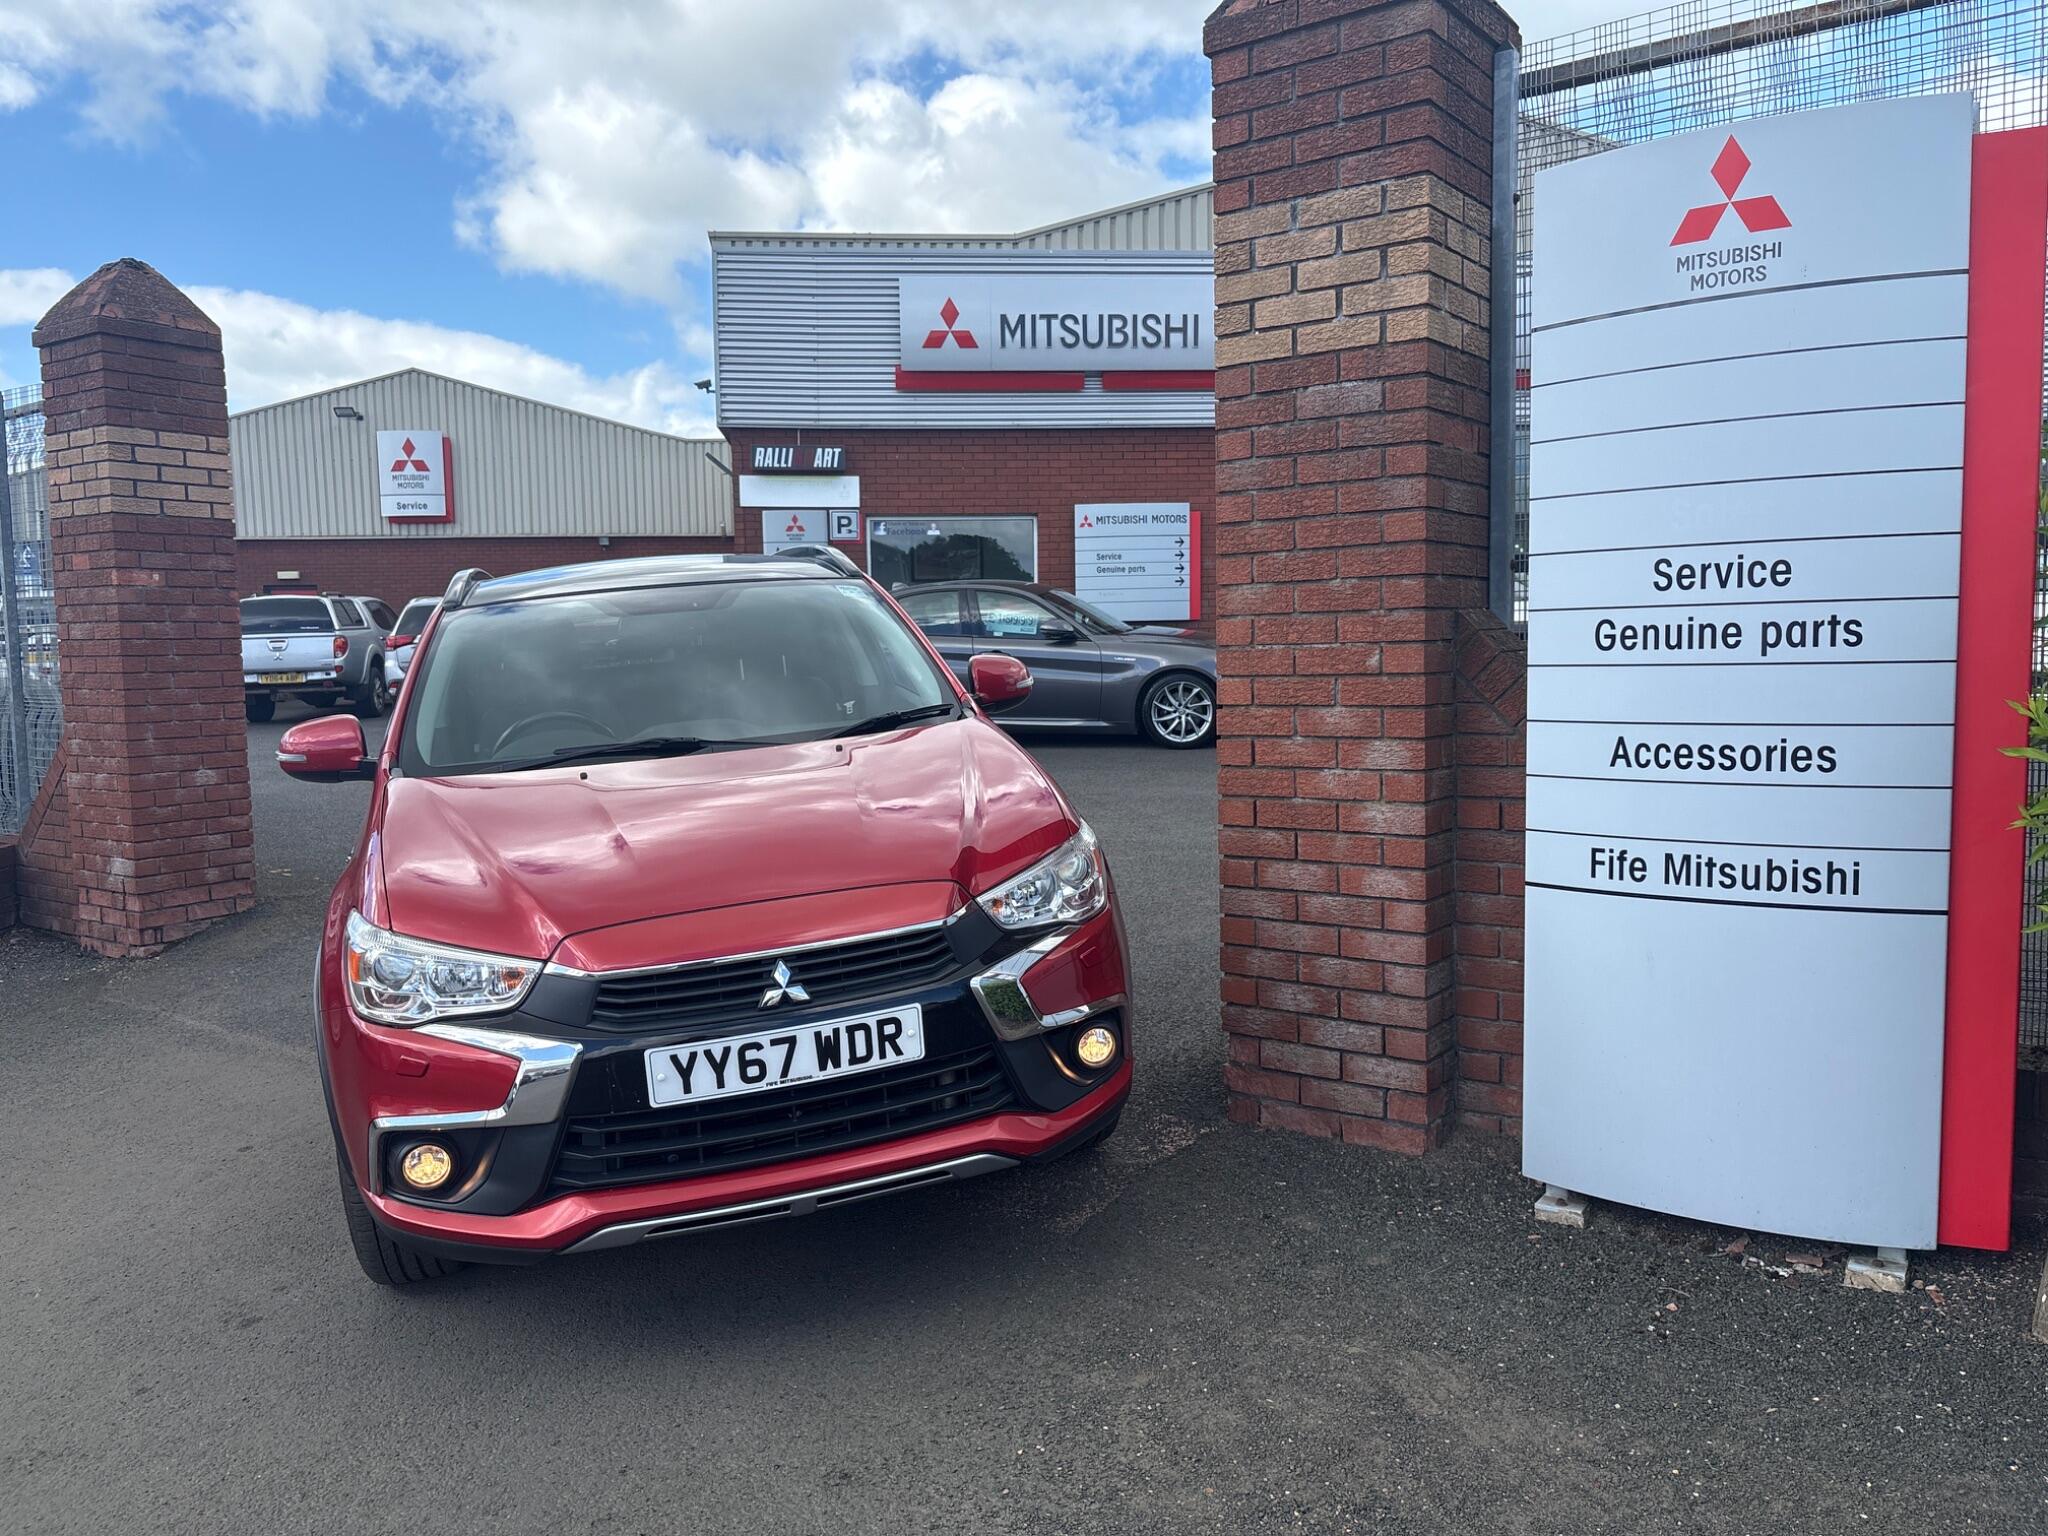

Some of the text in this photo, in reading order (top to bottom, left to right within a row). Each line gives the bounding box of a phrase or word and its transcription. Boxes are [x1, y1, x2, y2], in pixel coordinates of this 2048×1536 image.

[1677, 241, 1782, 273] MITSUBISHI
[1690, 265, 1767, 291] MOTORS
[999, 313, 1199, 349] MITSUBISHI
[754, 447, 842, 468] RALLI ART
[391, 474, 430, 482] MITSUBISHI
[396, 502, 428, 511] Service
[1096, 514, 1188, 525] MITSUBISHI MOTORS
[836, 516, 852, 535] P
[1096, 553, 1122, 561] Service
[1096, 565, 1146, 575] Genuine parts
[1653, 554, 1792, 591] Service
[1595, 614, 1863, 656] Genuine parts
[1609, 736, 1837, 773] Accessories
[1591, 848, 1860, 896] Fife Mitsubishi
[669, 1016, 904, 1095] YY67 WDR
